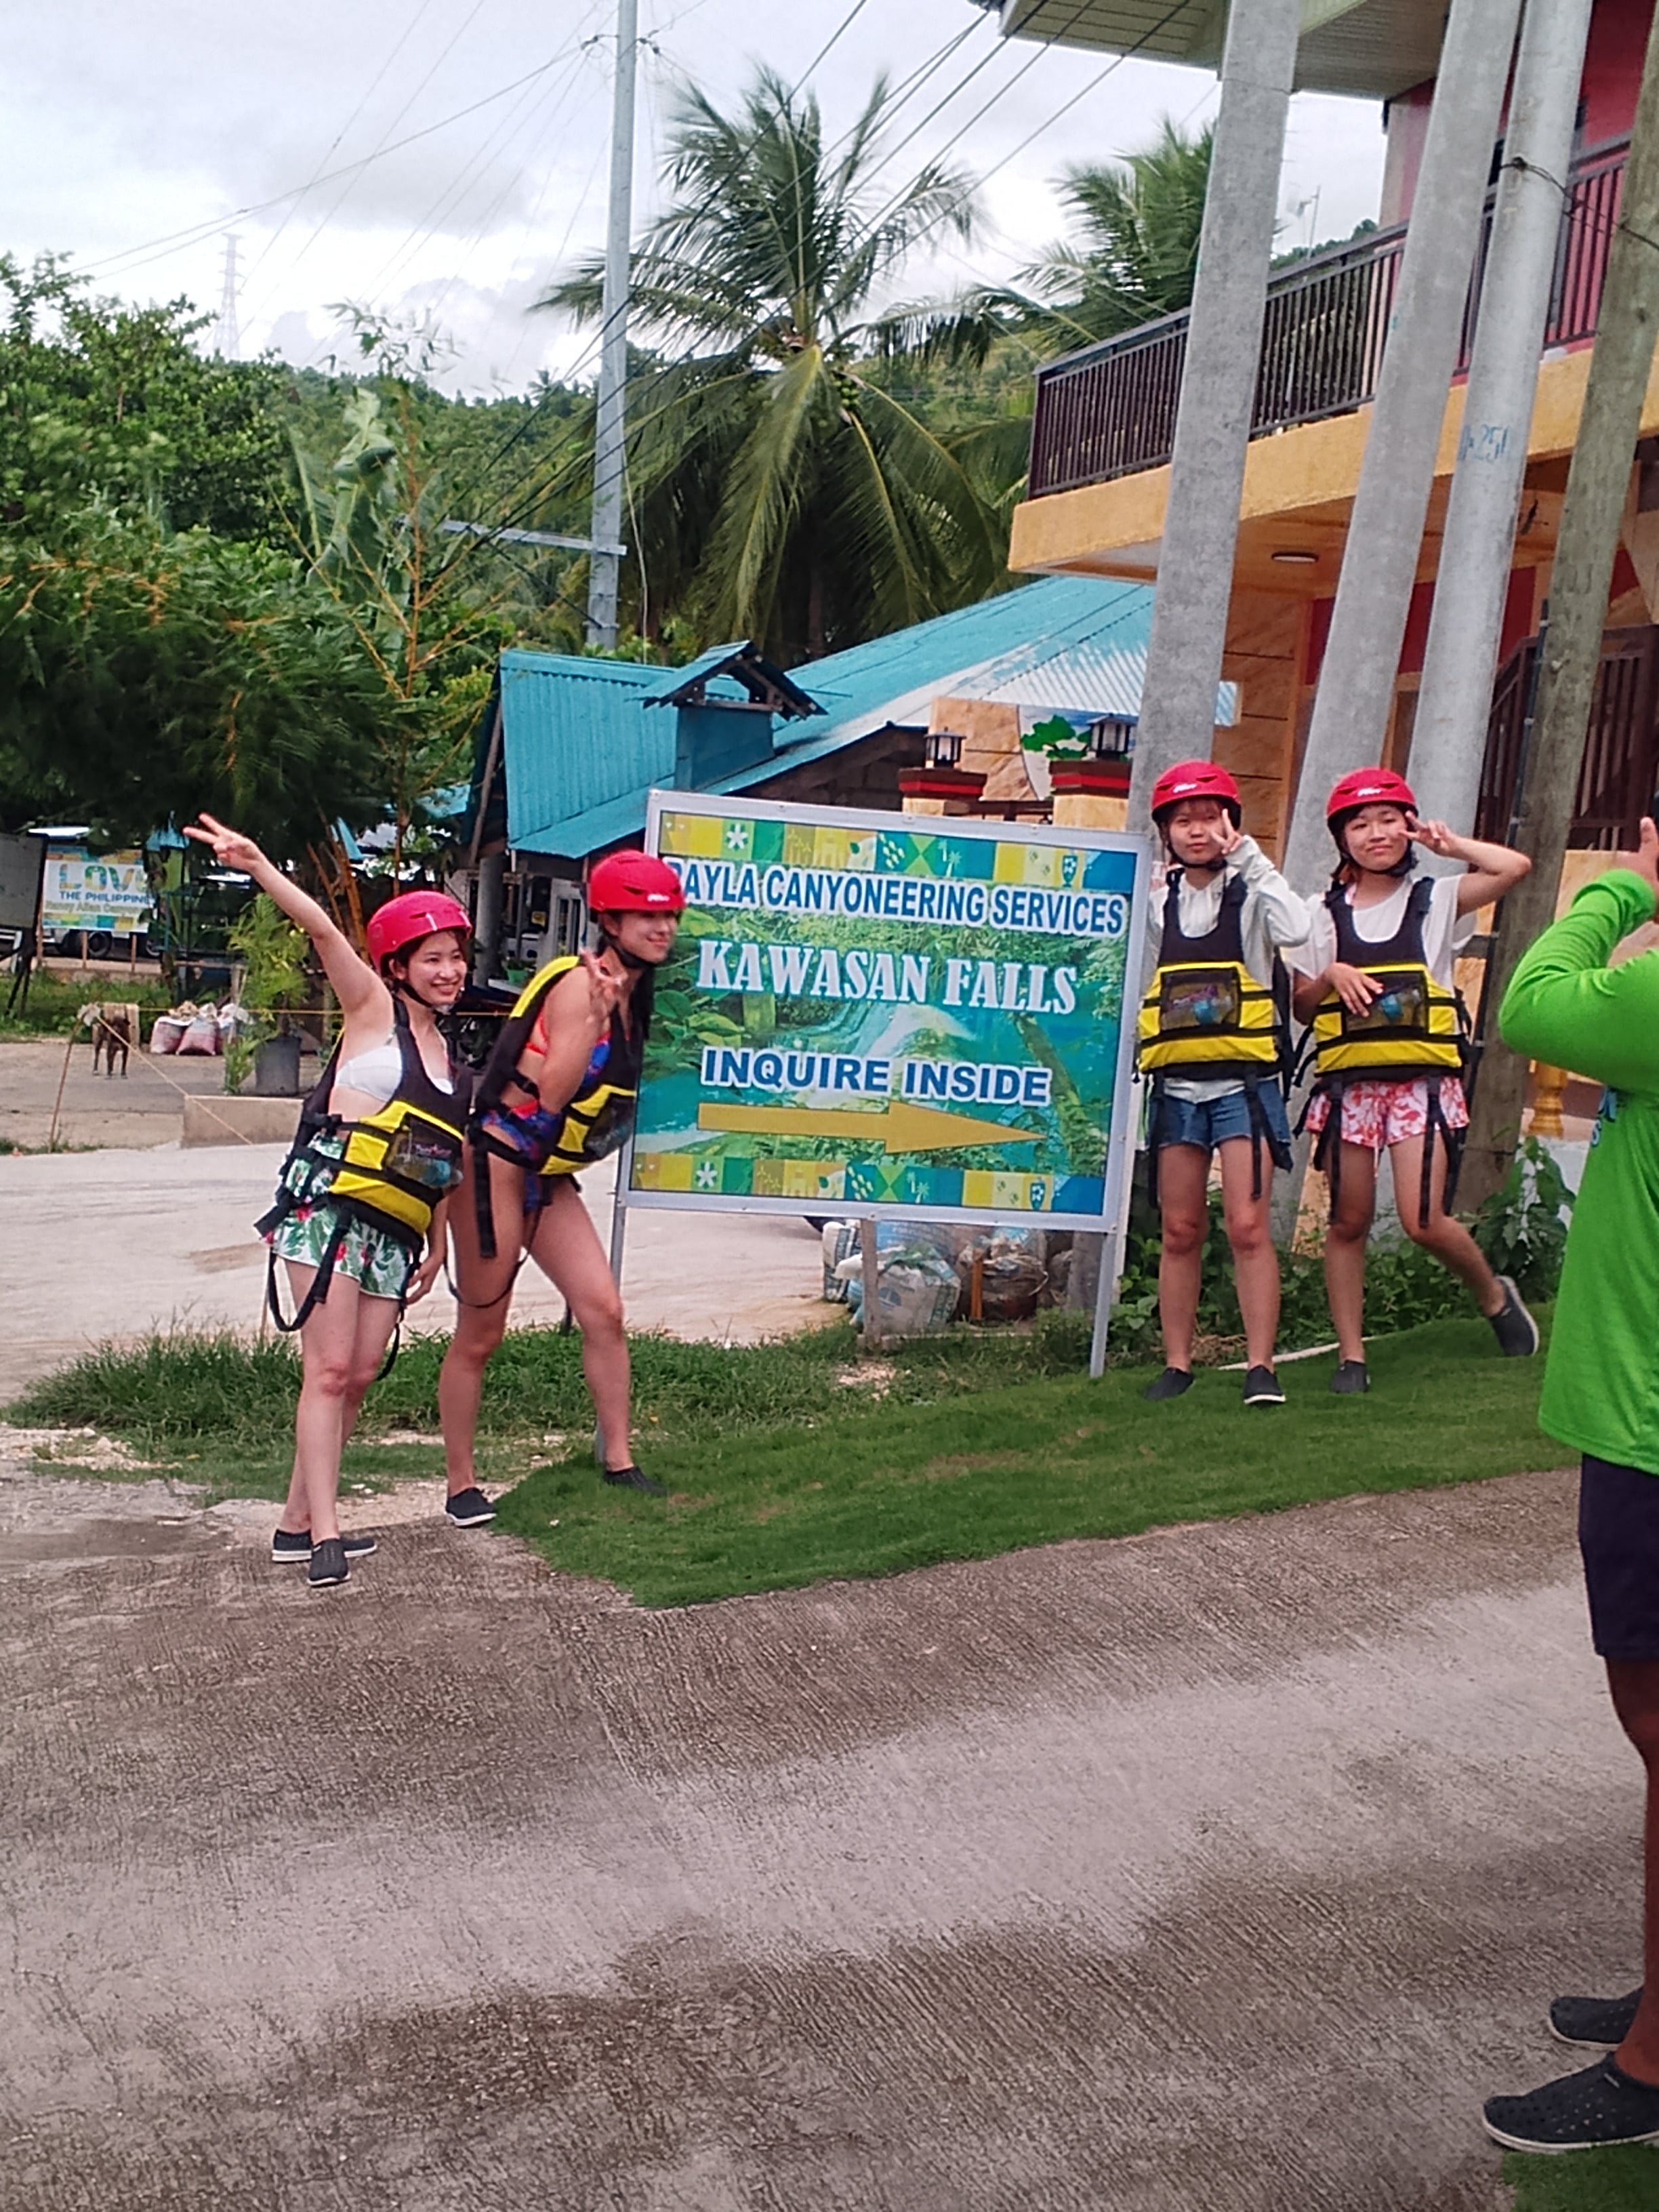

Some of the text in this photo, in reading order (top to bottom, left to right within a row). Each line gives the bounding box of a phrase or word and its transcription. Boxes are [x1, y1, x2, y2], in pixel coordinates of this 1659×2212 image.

[60, 890, 81, 900] THE
[665, 859, 1124, 935] AYLA CANYONEERING SERVICES
[696, 939, 1078, 1015] KAWASAN FALLS
[704, 1049, 1049, 1103] INQUIRE INSIDE
